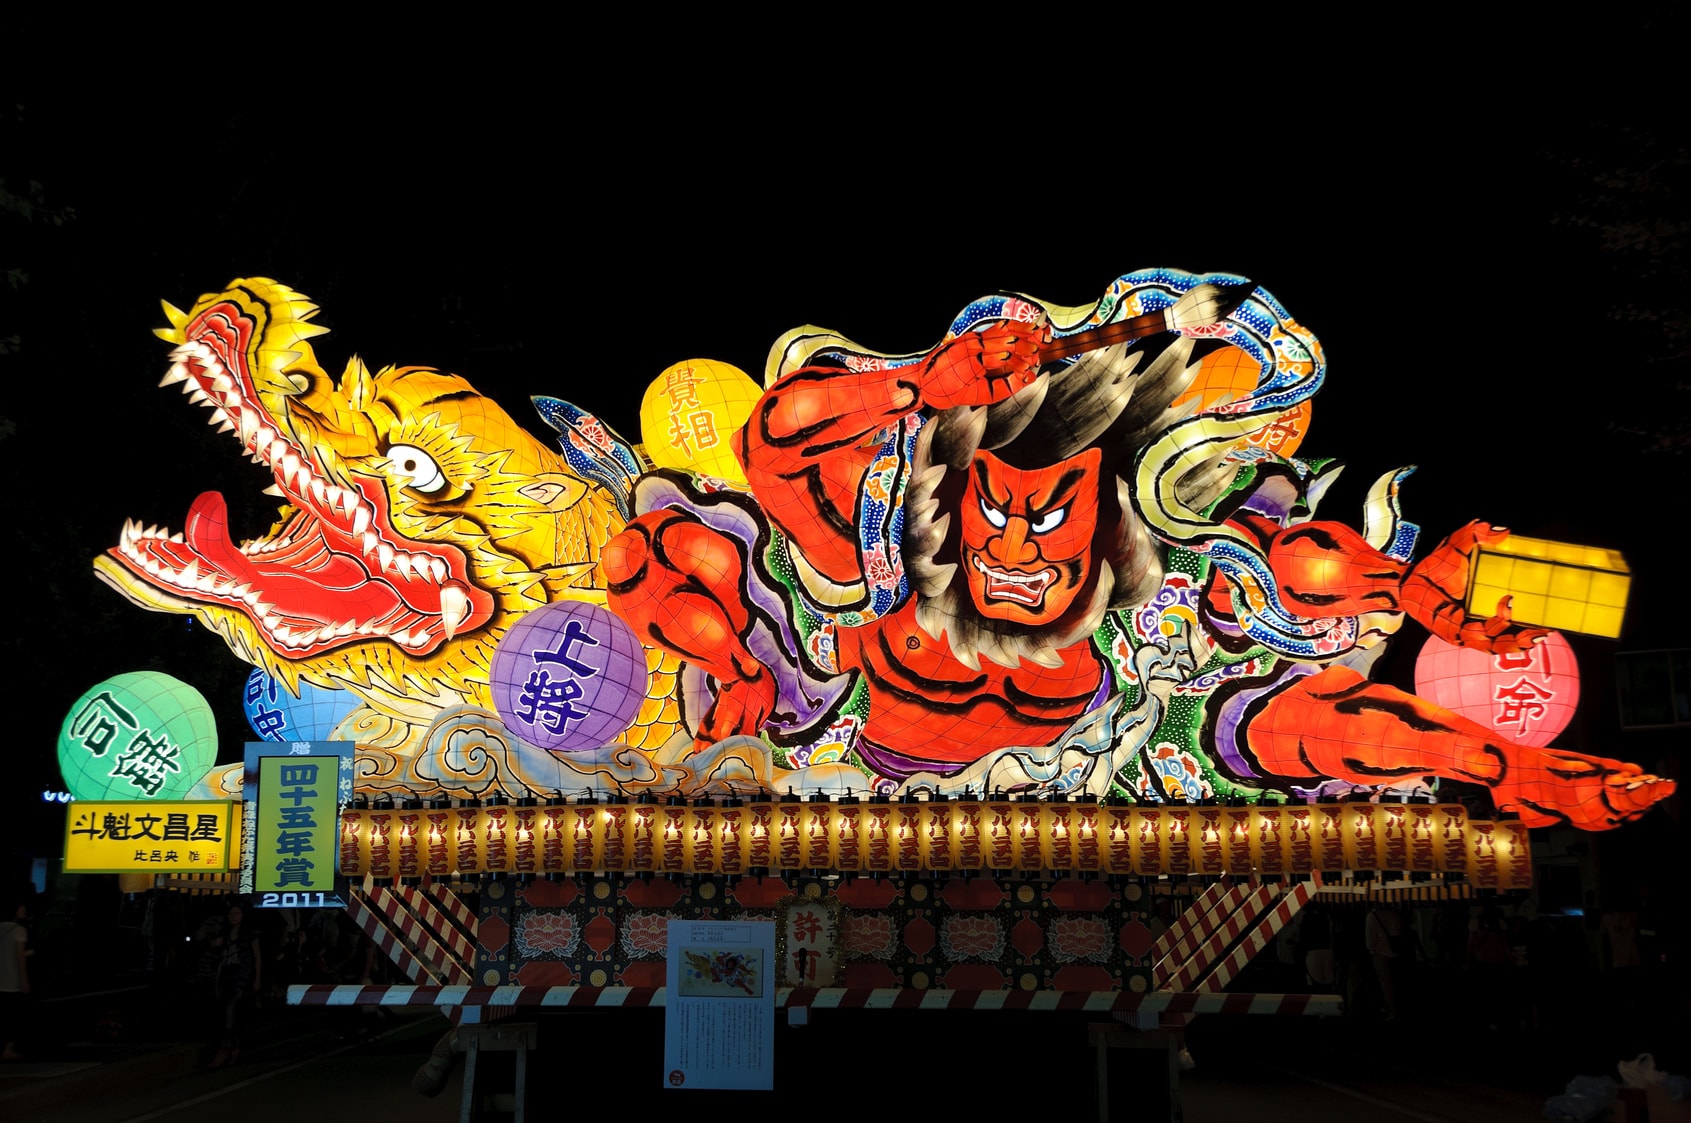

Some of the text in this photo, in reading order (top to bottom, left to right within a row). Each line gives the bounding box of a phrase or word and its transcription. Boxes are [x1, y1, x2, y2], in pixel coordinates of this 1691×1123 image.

[339, 755, 354, 771] 祝
[71, 811, 223, 843] 斗魁文昌星
[275, 763, 320, 888] 四十五年賞
[133, 849, 179, 863] 比呂央
[262, 892, 326, 908] 2011
[791, 910, 824, 981] 許可
